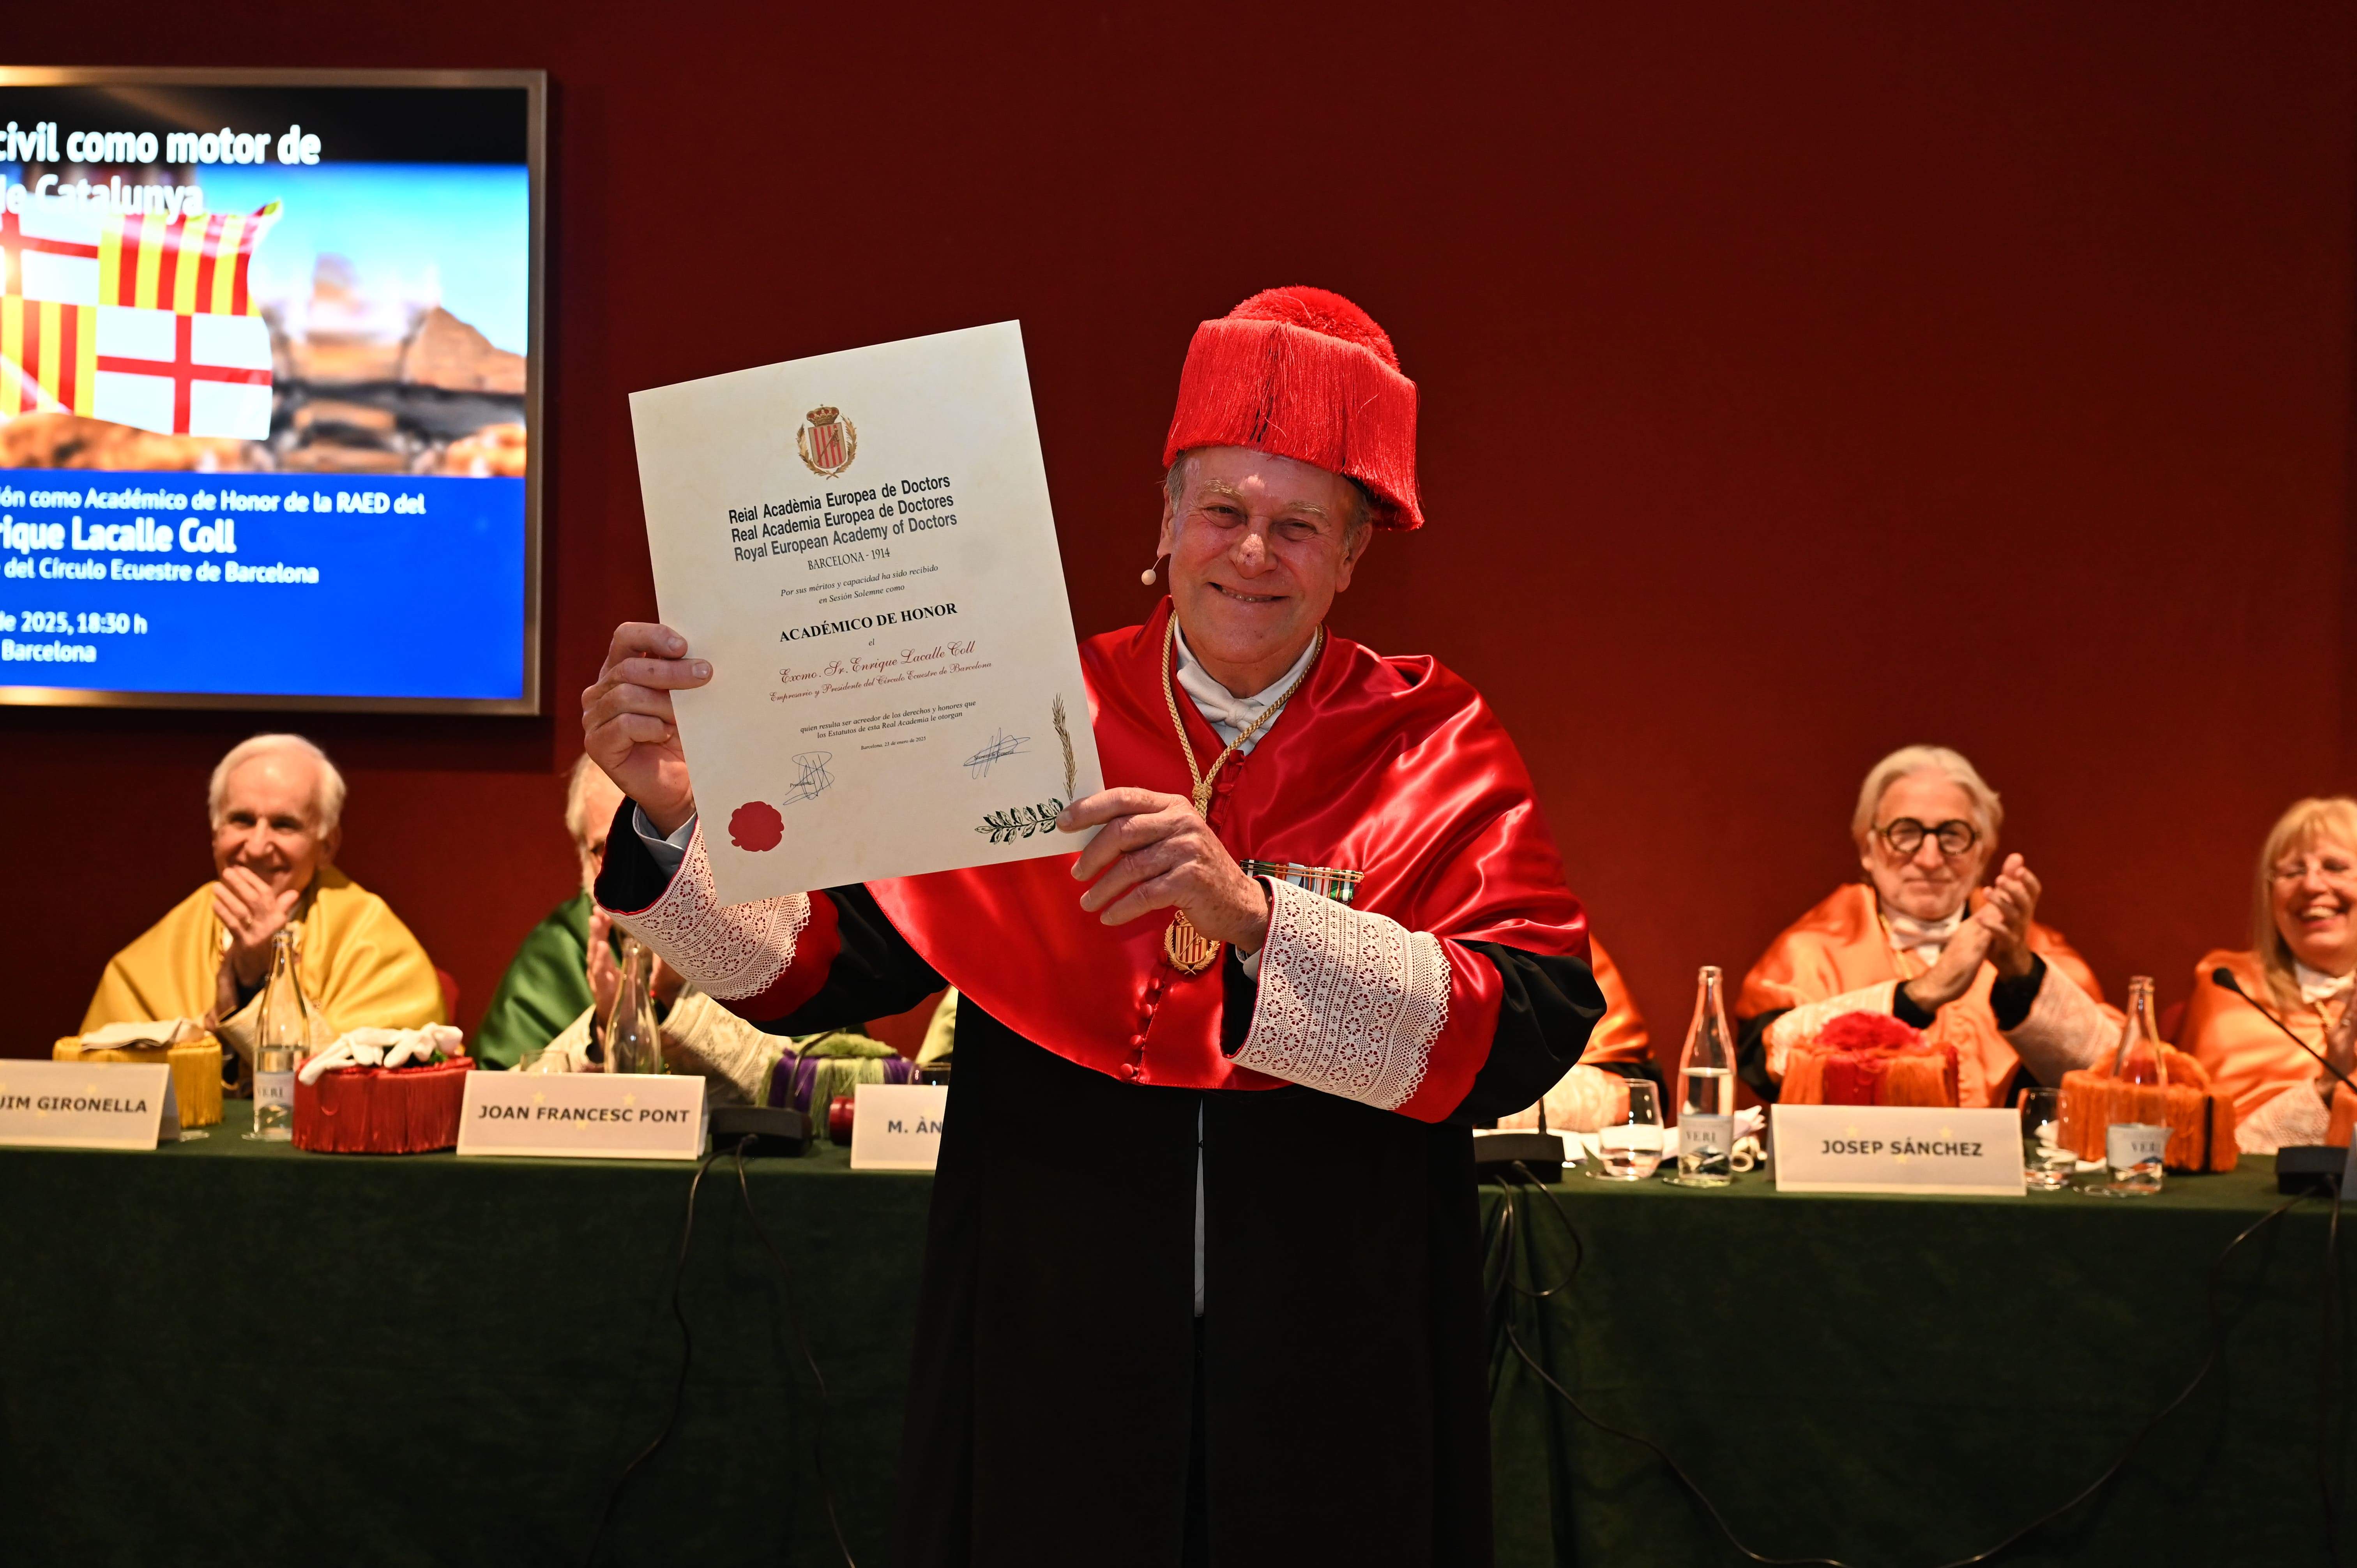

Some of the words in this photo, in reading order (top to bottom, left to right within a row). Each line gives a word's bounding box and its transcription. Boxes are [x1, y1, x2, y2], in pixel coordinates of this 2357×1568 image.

[67, 131, 159, 163] como
[166, 127, 270, 164] motor
[277, 125, 321, 164] de
[35, 174, 203, 225] Catalunya
[0, 485, 26, 507] ón
[29, 491, 82, 508] como
[84, 487, 188, 509] Académico
[191, 489, 217, 510] de
[221, 489, 281, 511] Honor
[284, 491, 310, 512] de
[313, 491, 332, 513] la
[336, 491, 390, 514] RAED
[394, 493, 426, 514] del
[729, 506, 758, 524] Reial
[763, 496, 821, 518] Acadèmia
[826, 489, 876, 507] Europea
[882, 483, 896, 498] de
[901, 476, 950, 494] Doctors
[731, 525, 758, 542] Real
[763, 516, 820, 537] Academia
[824, 509, 875, 526] Europea
[879, 503, 894, 517] de
[898, 496, 954, 514] Doctores
[0, 514, 65, 554] ique
[72, 516, 173, 551] Lacalle
[179, 517, 237, 553] Coll
[734, 543, 767, 562] Royal
[771, 535, 829, 555] European
[833, 526, 887, 545] Academy
[892, 519, 904, 534] of
[908, 514, 957, 532] Doctors
[4, 556, 36, 579] del
[111, 558, 193, 581] Ecuestre
[196, 560, 221, 582] de
[225, 561, 319, 584] Barcelona
[807, 552, 864, 570] BARCELONA
[871, 547, 890, 560] 1914
[809, 582, 835, 593] méritos
[843, 574, 880, 586] capacidad
[892, 570, 907, 579] sido
[909, 565, 938, 575] recibido
[829, 592, 852, 602] Sesión
[854, 588, 884, 599] Solemne
[885, 585, 905, 593] como
[21, 611, 74, 636] 2025,
[77, 612, 130, 634] 18:30
[134, 613, 147, 634] h
[779, 617, 873, 642] ACADÉMICO
[875, 613, 897, 626] DE
[900, 602, 958, 622] HONOR
[2, 639, 97, 662] Barcelona
[824, 660, 848, 676] Sr.
[850, 657, 897, 673] Enrique
[901, 646, 945, 664] Lacalle
[948, 641, 975, 657] Coll
[770, 690, 812, 703] Empresario
[815, 690, 819, 698] y
[822, 682, 861, 693] Presidente
[864, 678, 875, 687] del
[907, 670, 937, 680] Ecuestre
[939, 667, 947, 675] de
[950, 661, 992, 673] Barcelona
[800, 725, 817, 733] quien
[853, 715, 881, 724] acreedor
[903, 708, 931, 717] derechos
[829, 728, 857, 737] Estatutos
[898, 717, 929, 726] Academia
[37, 1096, 147, 1113] GIRONELLA
[478, 1105, 530, 1119] JOAN
[536, 1107, 634, 1122] FRANCESC
[639, 1109, 691, 1123] PONT
[888, 1120, 908, 1134] M.
[1686, 1131, 1717, 1142] VERI
[1821, 1140, 1883, 1156] JOSEP
[1891, 1137, 1983, 1157] SÁNCHEZ
